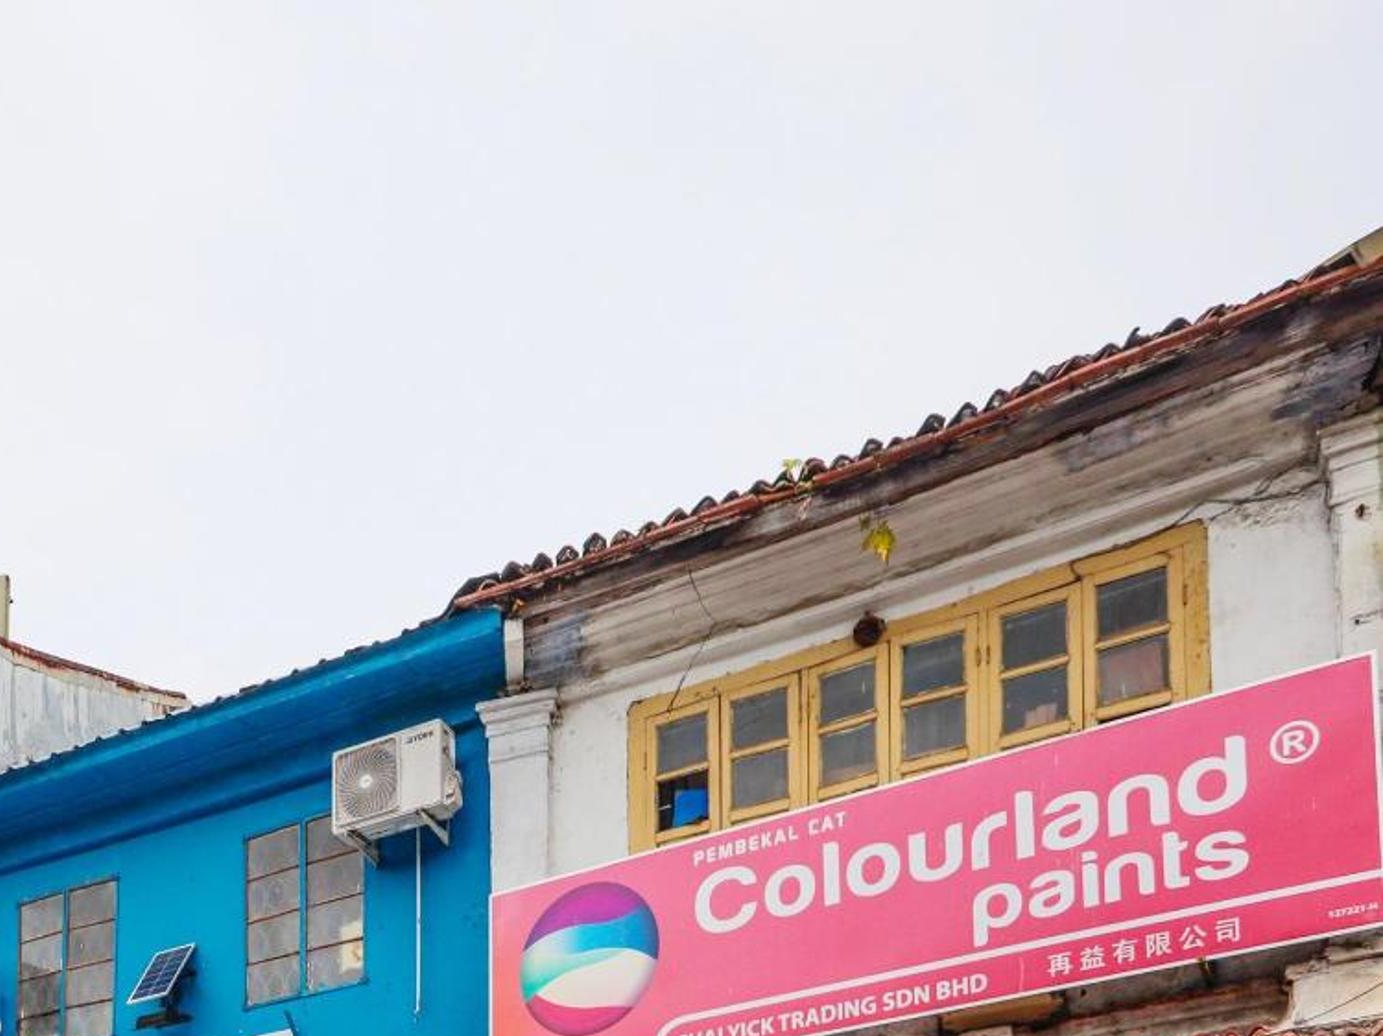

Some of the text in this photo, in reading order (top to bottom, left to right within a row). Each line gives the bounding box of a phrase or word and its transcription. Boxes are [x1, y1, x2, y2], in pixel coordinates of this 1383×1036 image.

[693, 811, 846, 867] PEMBEKAL CAT
[694, 735, 1248, 934] Colourland
[972, 829, 1250, 948] paints
[1047, 916, 1241, 978] 再益有限公司
[778, 996, 877, 1032] TRADING
[883, 985, 930, 1012] SDN
[935, 973, 989, 1001] BHD
